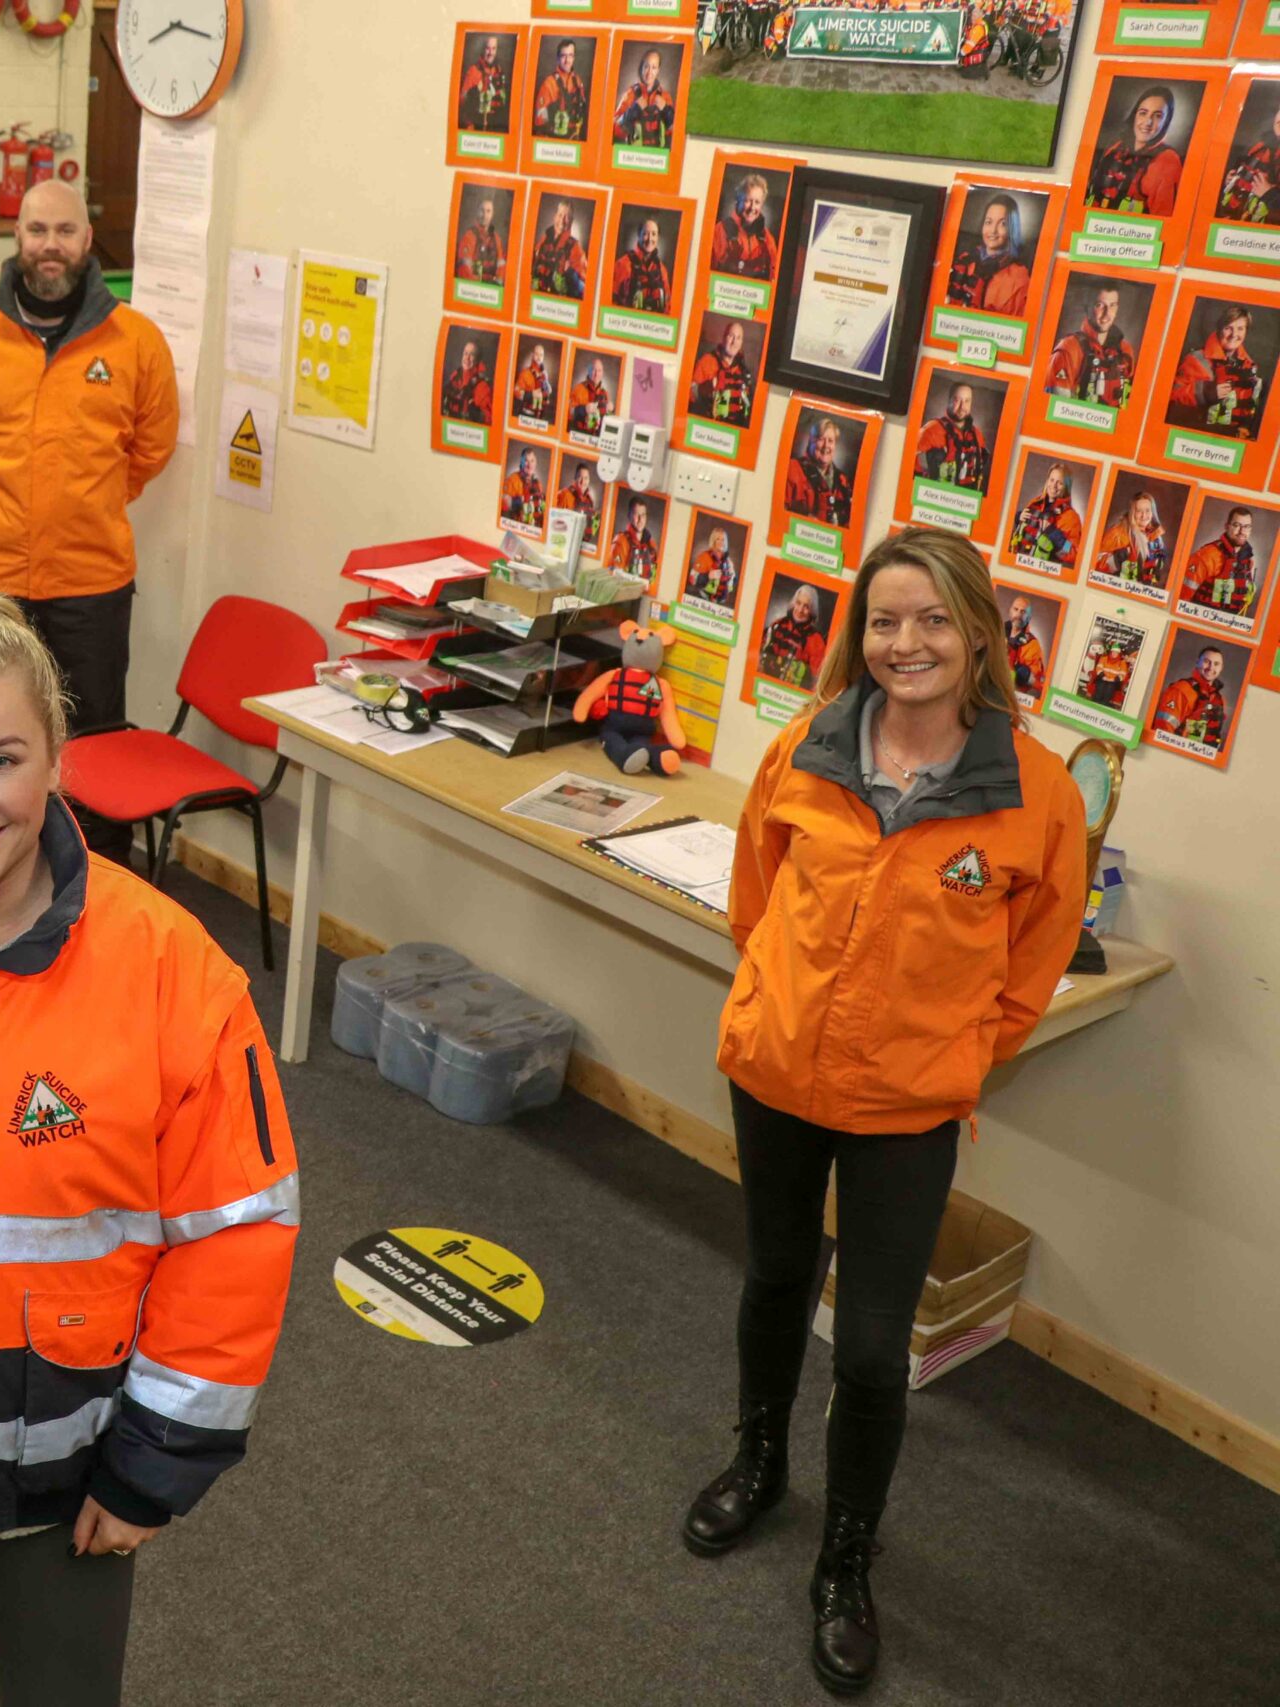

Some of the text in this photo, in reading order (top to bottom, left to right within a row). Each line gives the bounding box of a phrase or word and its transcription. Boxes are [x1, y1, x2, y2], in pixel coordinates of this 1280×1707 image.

[818, 18, 932, 33] LIMERICK SUICIDE
[1130, 22, 1199, 32] Sarah Counihan
[849, 32, 896, 46] WATCH
[1093, 224, 1152, 239] Sarah Culhane
[1084, 243, 1148, 257] Training Officer
[1222, 236, 1267, 251] Geraldine
[837, 277, 864, 288] WINNER
[939, 319, 1017, 344] Elaine Fitzpatrick Leahy
[1060, 405, 1110, 426] Shane Crotty
[234, 454, 257, 471] CCTV
[1181, 443, 1230, 464] Terry Byrne
[924, 489, 975, 511] Alex Henriques
[918, 511, 967, 530] Vice Chairman
[791, 546, 835, 566] Liaison Officer
[1178, 602, 1199, 617] Mark
[766, 706, 792, 721] Secretar
[1053, 699, 1126, 735] Recruitment Officer
[1156, 729, 1214, 759] Seamus Martin
[934, 842, 976, 877] LIMERICK
[939, 876, 983, 897] WATCH
[7, 1071, 37, 1135] LIMERICK
[41, 1070, 88, 1115] SUICIDE
[18, 1120, 86, 1148] WATCH
[364, 1252, 415, 1286] Social
[410, 1282, 480, 1329] Distance
[375, 1241, 507, 1325] Please Keep Your
